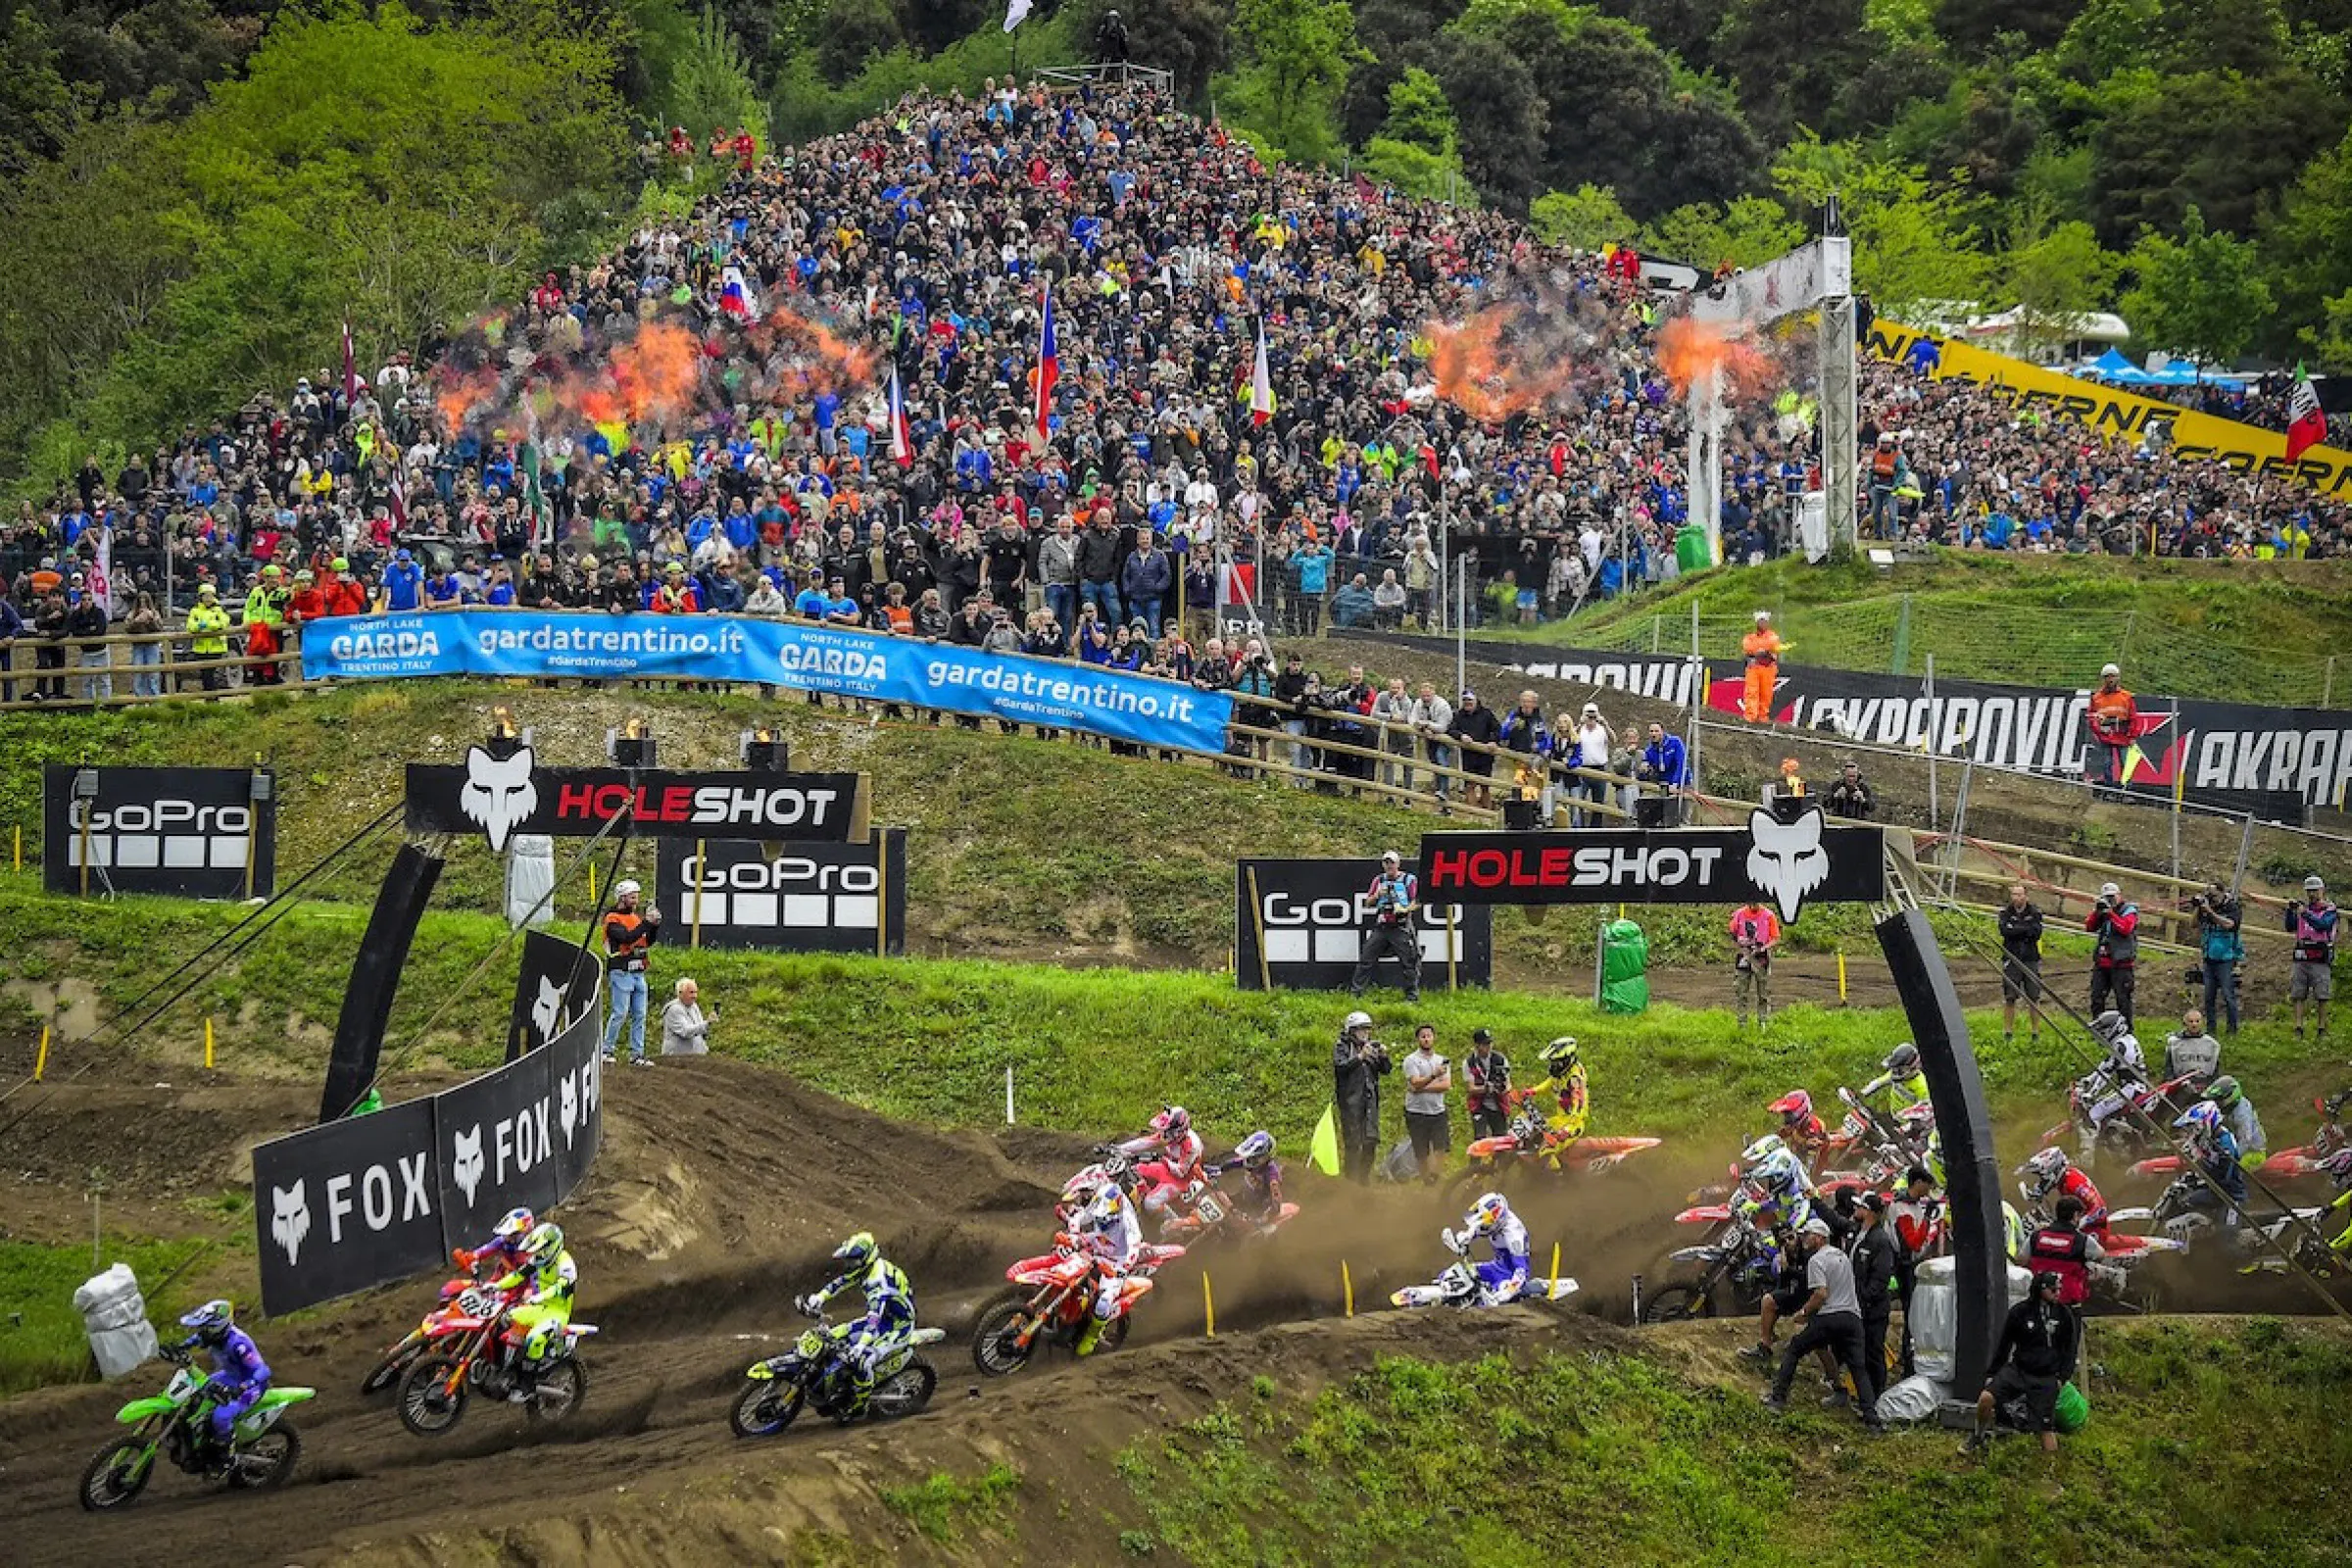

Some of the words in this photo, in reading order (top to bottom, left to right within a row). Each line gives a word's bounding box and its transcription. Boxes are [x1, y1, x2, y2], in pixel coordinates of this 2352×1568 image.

[349, 620, 389, 632] NORTH
[393, 618, 423, 629] LAKE
[478, 623, 744, 656] gardatrentino.it
[801, 633, 842, 646] NORTH
[846, 639, 875, 651] LAKE
[330, 631, 439, 661] GARDA
[547, 656, 637, 668] #GardaTrentino
[780, 643, 887, 680] GARDA
[341, 662, 399, 672] TRENTINO
[402, 661, 432, 670] ITALY
[784, 672, 841, 688] TRENTINO
[846, 680, 877, 692] ITALY
[927, 661, 1194, 723] gardatrentino.it
[994, 696, 1085, 720] #GardaTrentino
[69, 799, 251, 833] GoPro
[557, 783, 837, 826] HOLESHOT
[680, 855, 880, 892] GoPro
[1430, 847, 1723, 888] HOLESHOT
[1263, 892, 1463, 926] GoPo
[496, 1096, 551, 1186] FOX
[326, 1152, 431, 1244] FOX
